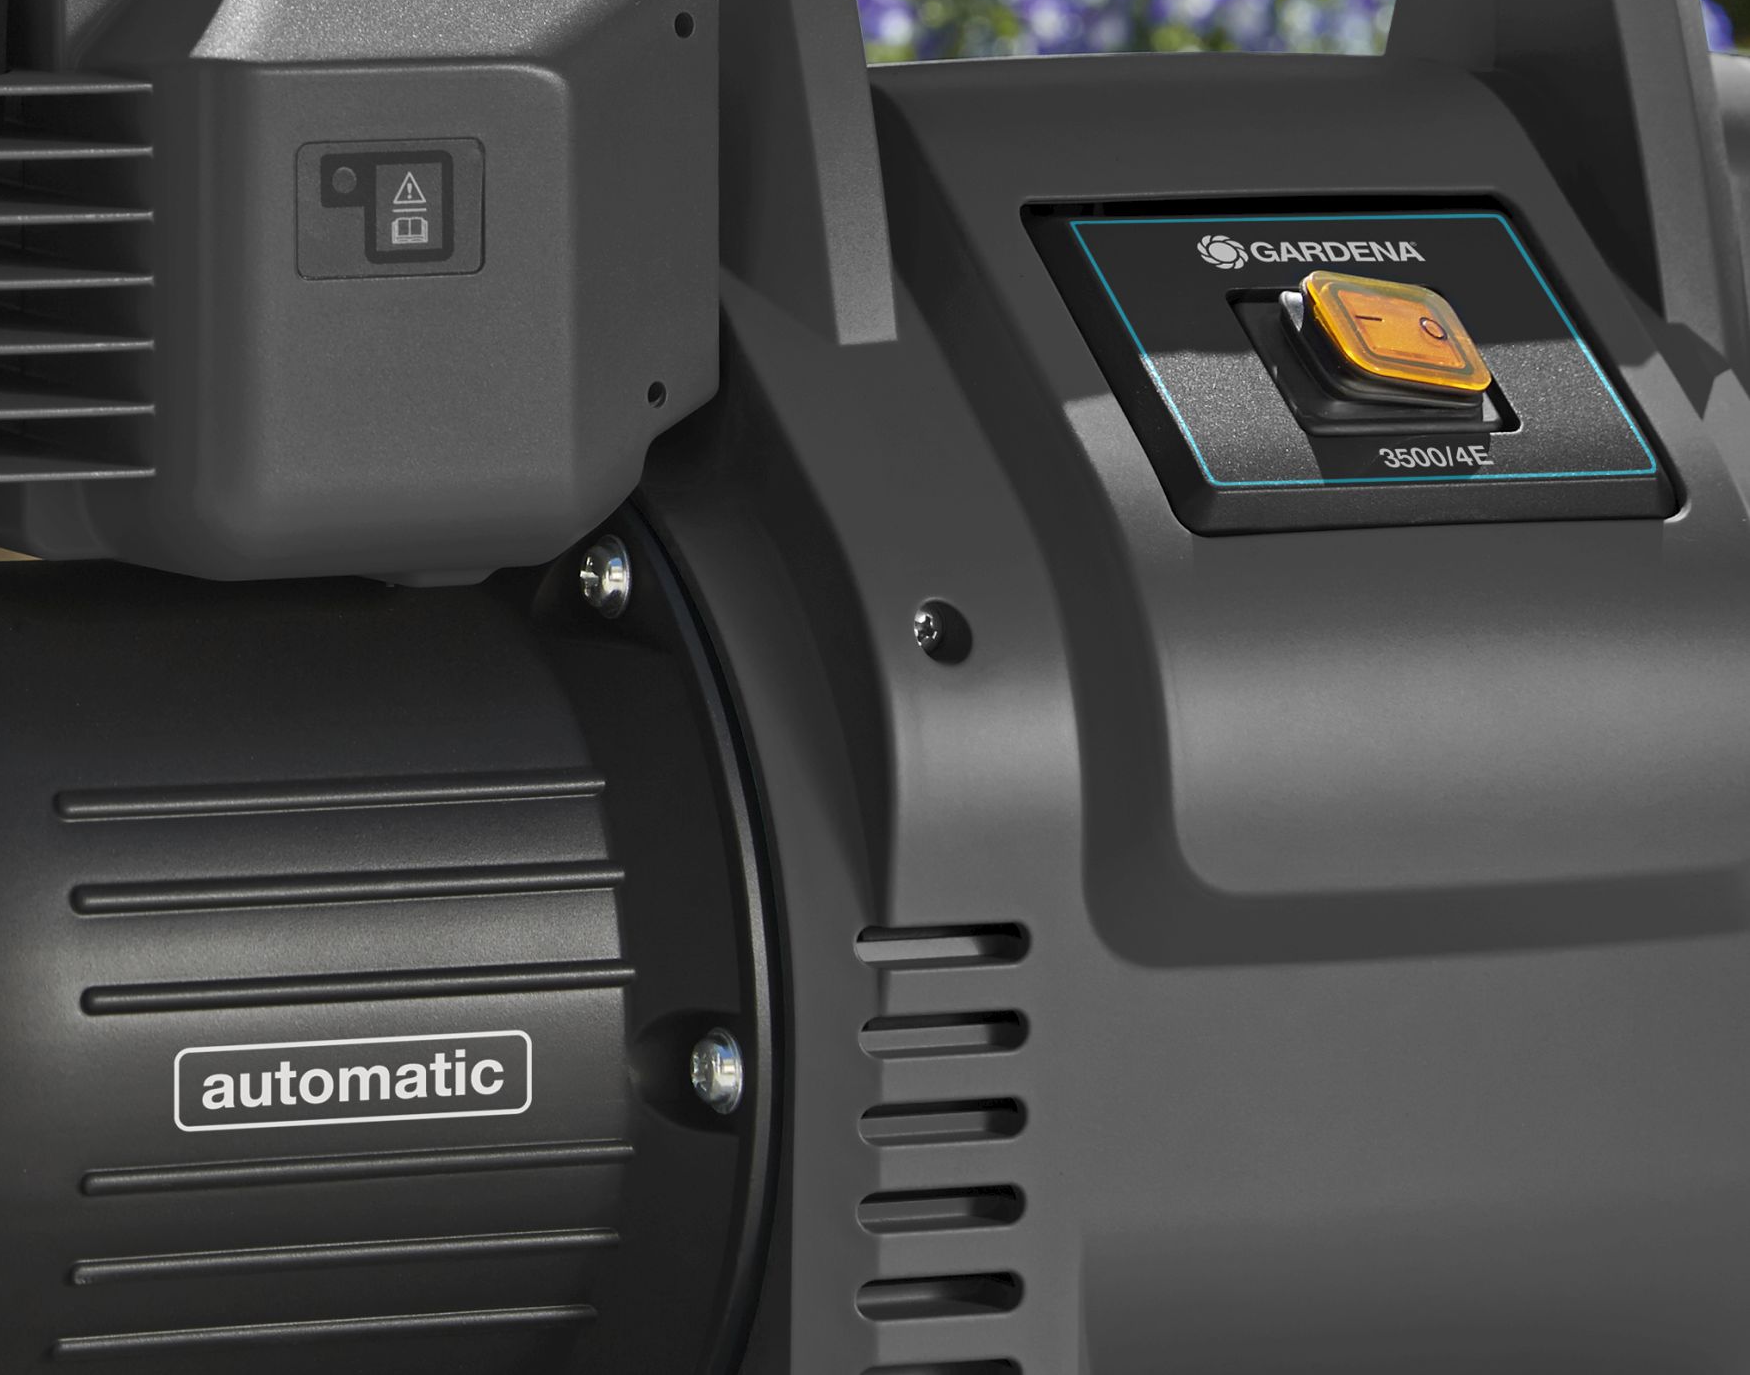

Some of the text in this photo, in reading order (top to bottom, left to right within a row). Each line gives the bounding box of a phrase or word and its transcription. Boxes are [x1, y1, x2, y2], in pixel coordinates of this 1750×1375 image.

[1249, 241, 1426, 263] GARDENA
[1378, 444, 1495, 468] 3500/4E
[201, 1048, 505, 1111] automatic
